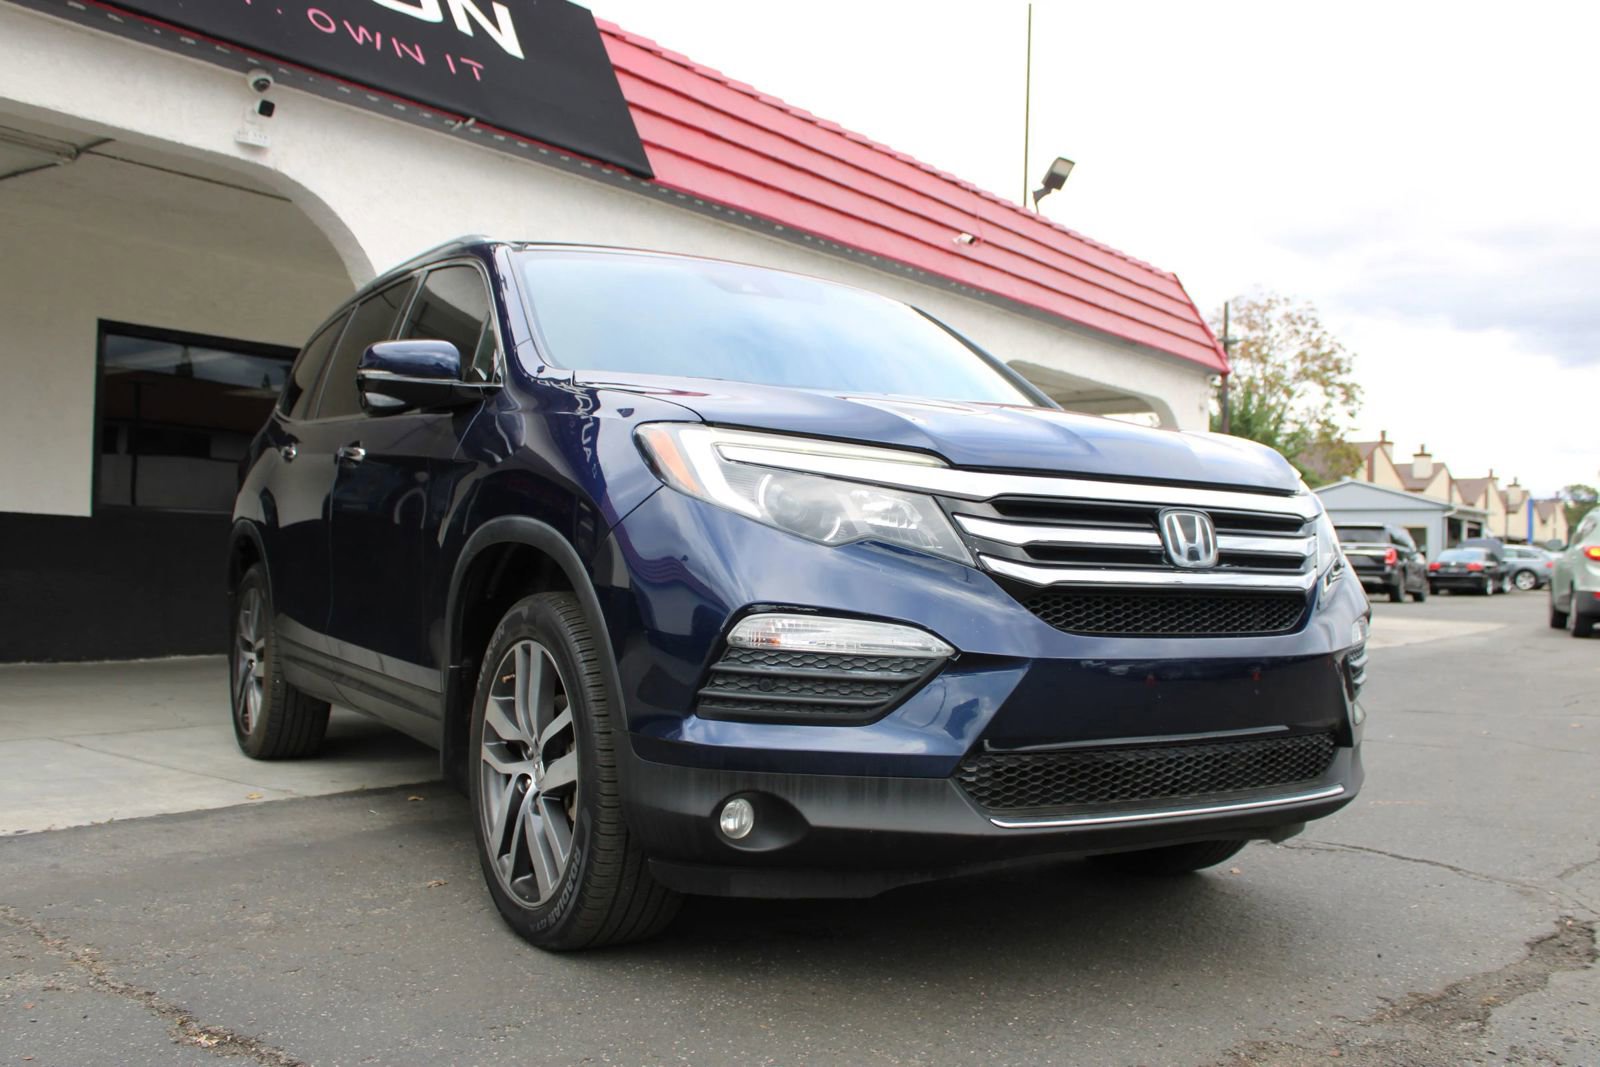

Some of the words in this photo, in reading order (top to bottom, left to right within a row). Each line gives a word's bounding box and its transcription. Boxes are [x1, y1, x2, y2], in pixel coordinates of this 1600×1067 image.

[308, 8, 427, 65] OWN
[445, 53, 484, 81] IT
[548, 845, 581, 927] ROADIAN
